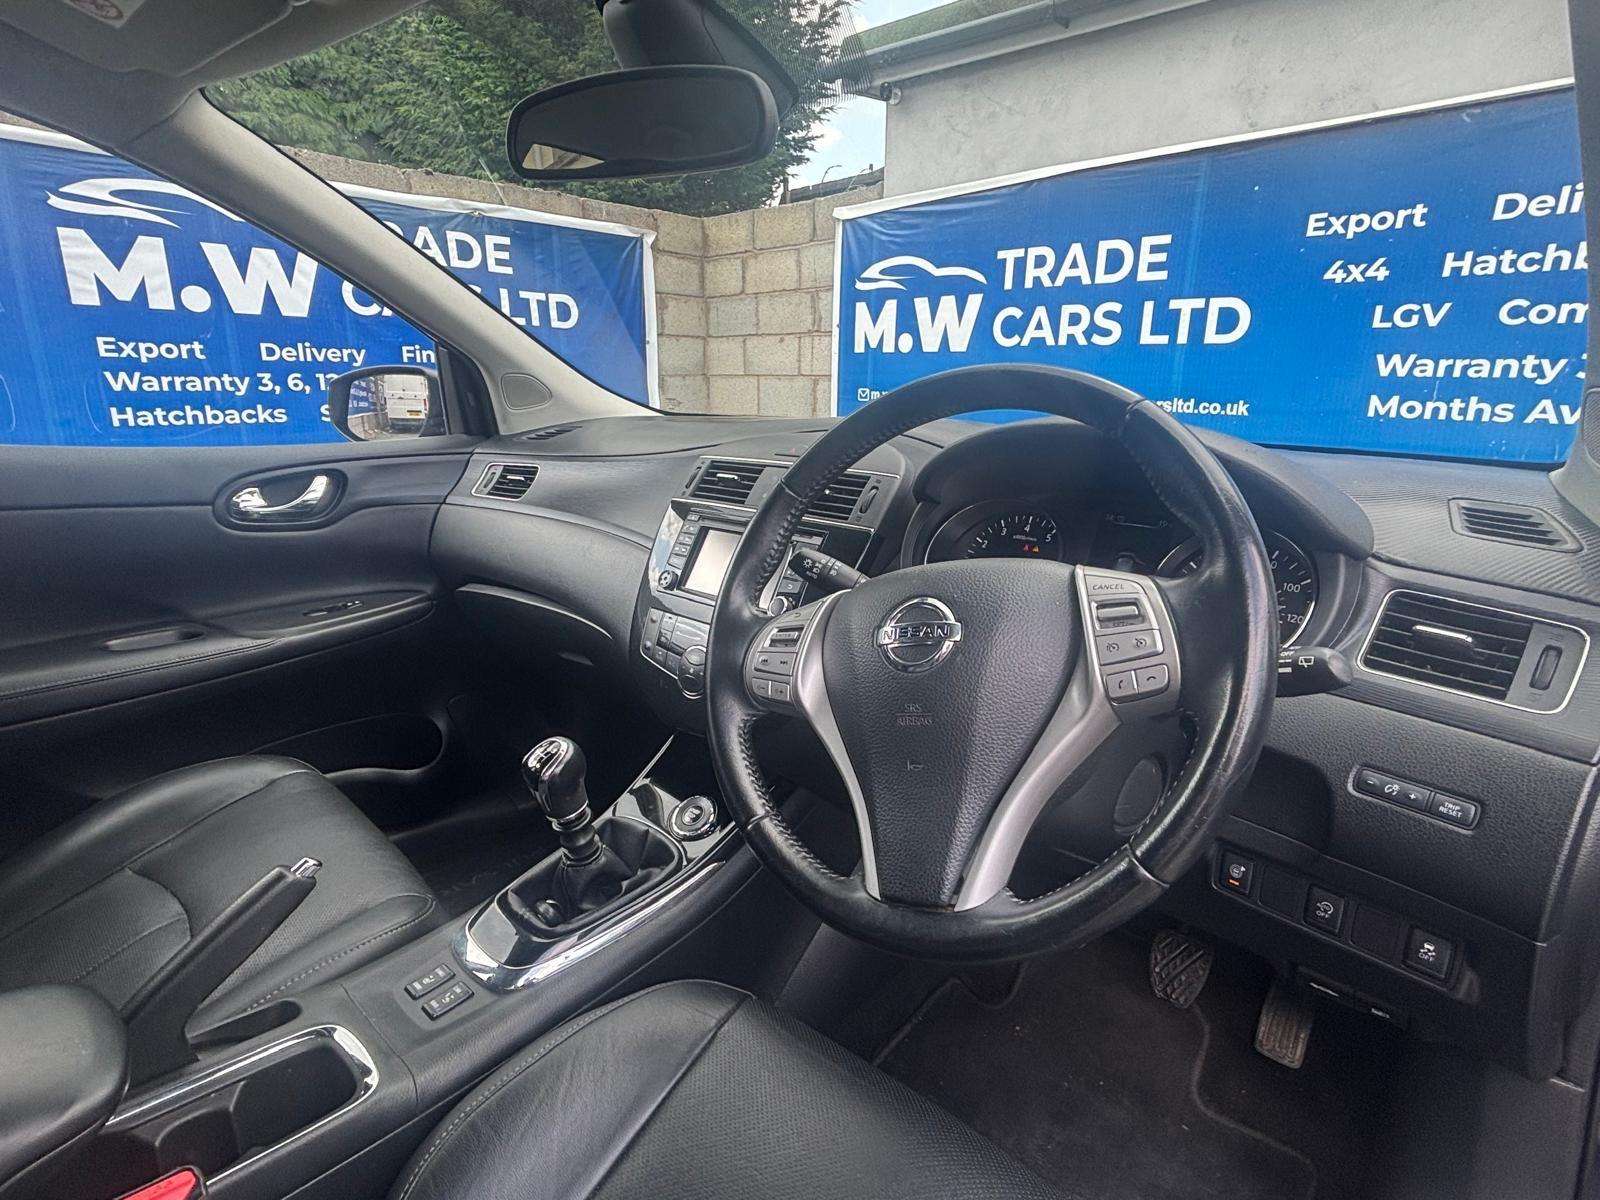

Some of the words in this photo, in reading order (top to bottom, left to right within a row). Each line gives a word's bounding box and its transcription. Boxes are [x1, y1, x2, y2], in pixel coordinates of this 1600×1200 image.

[1492, 181, 1585, 221] Deli
[1305, 203, 1429, 239] Export
[384, 221, 514, 275] ADE
[56, 226, 319, 318] M.W
[997, 234, 1173, 291] TRADE
[1322, 256, 1390, 284] 4x4
[498, 287, 580, 330] LTD
[992, 301, 1123, 348] CARS
[1138, 296, 1252, 346] LTD
[1371, 302, 1453, 329] LGV
[853, 293, 984, 354] M.W
[96, 336, 207, 363] Export
[259, 341, 367, 367] Delivery
[401, 343, 436, 364] Fin
[1375, 353, 1568, 386] Warranty
[103, 371, 250, 396] Warranty
[256, 372, 281, 395] 3,
[286, 373, 311, 395] 6,
[109, 403, 288, 428] Hatchbacks
[1156, 397, 1250, 417] rsltd.co.uk
[1366, 394, 1516, 423] Months
[1523, 398, 1582, 426] Av
[1092, 583, 1125, 591] CANCEL
[1282, 582, 1301, 593] 100
[882, 624, 950, 641] NISSAN
[1286, 613, 1305, 625] 120
[1280, 650, 1296, 658] OFF
[1438, 805, 1463, 818] RESET
